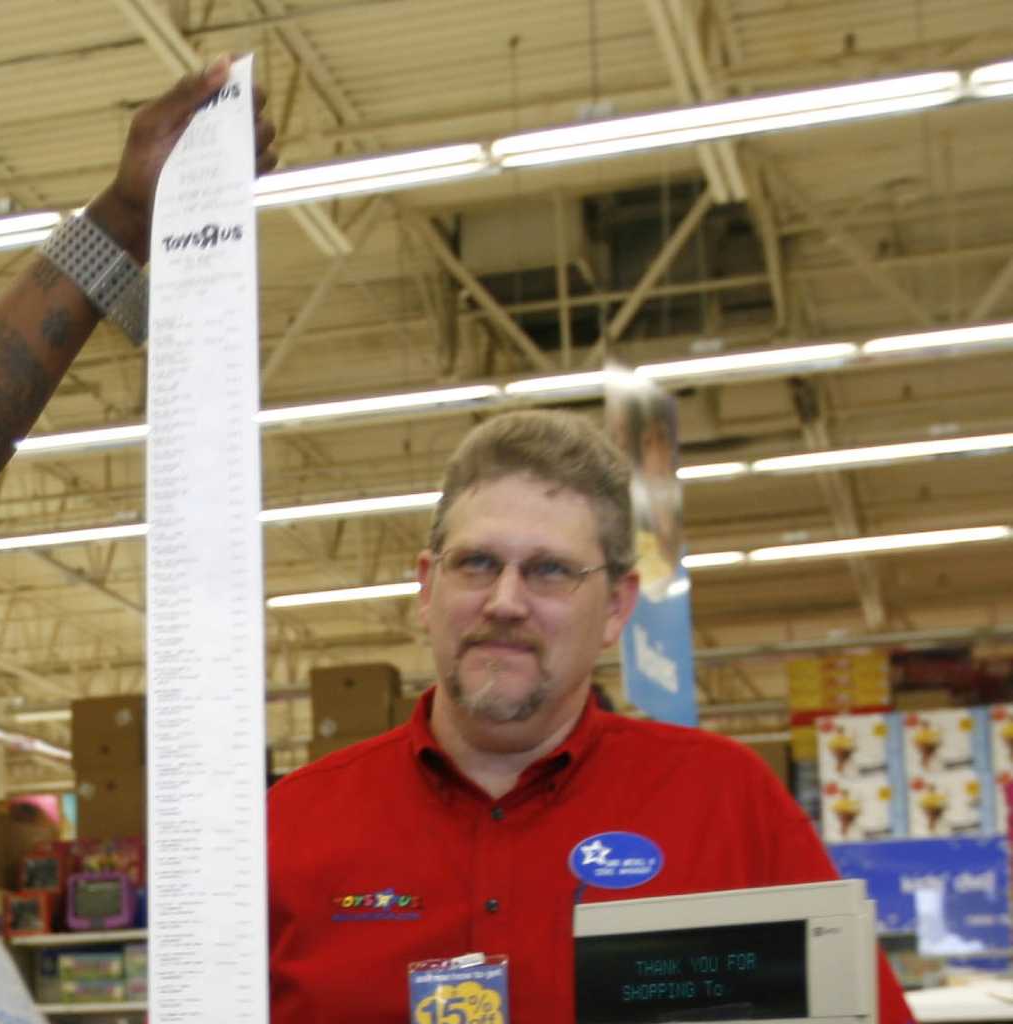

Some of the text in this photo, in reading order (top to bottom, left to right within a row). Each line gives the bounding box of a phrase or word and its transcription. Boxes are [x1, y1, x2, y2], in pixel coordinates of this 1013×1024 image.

[636, 952, 758, 978] THANK YOU FOR
[622, 982, 697, 1002] SHOPPING
